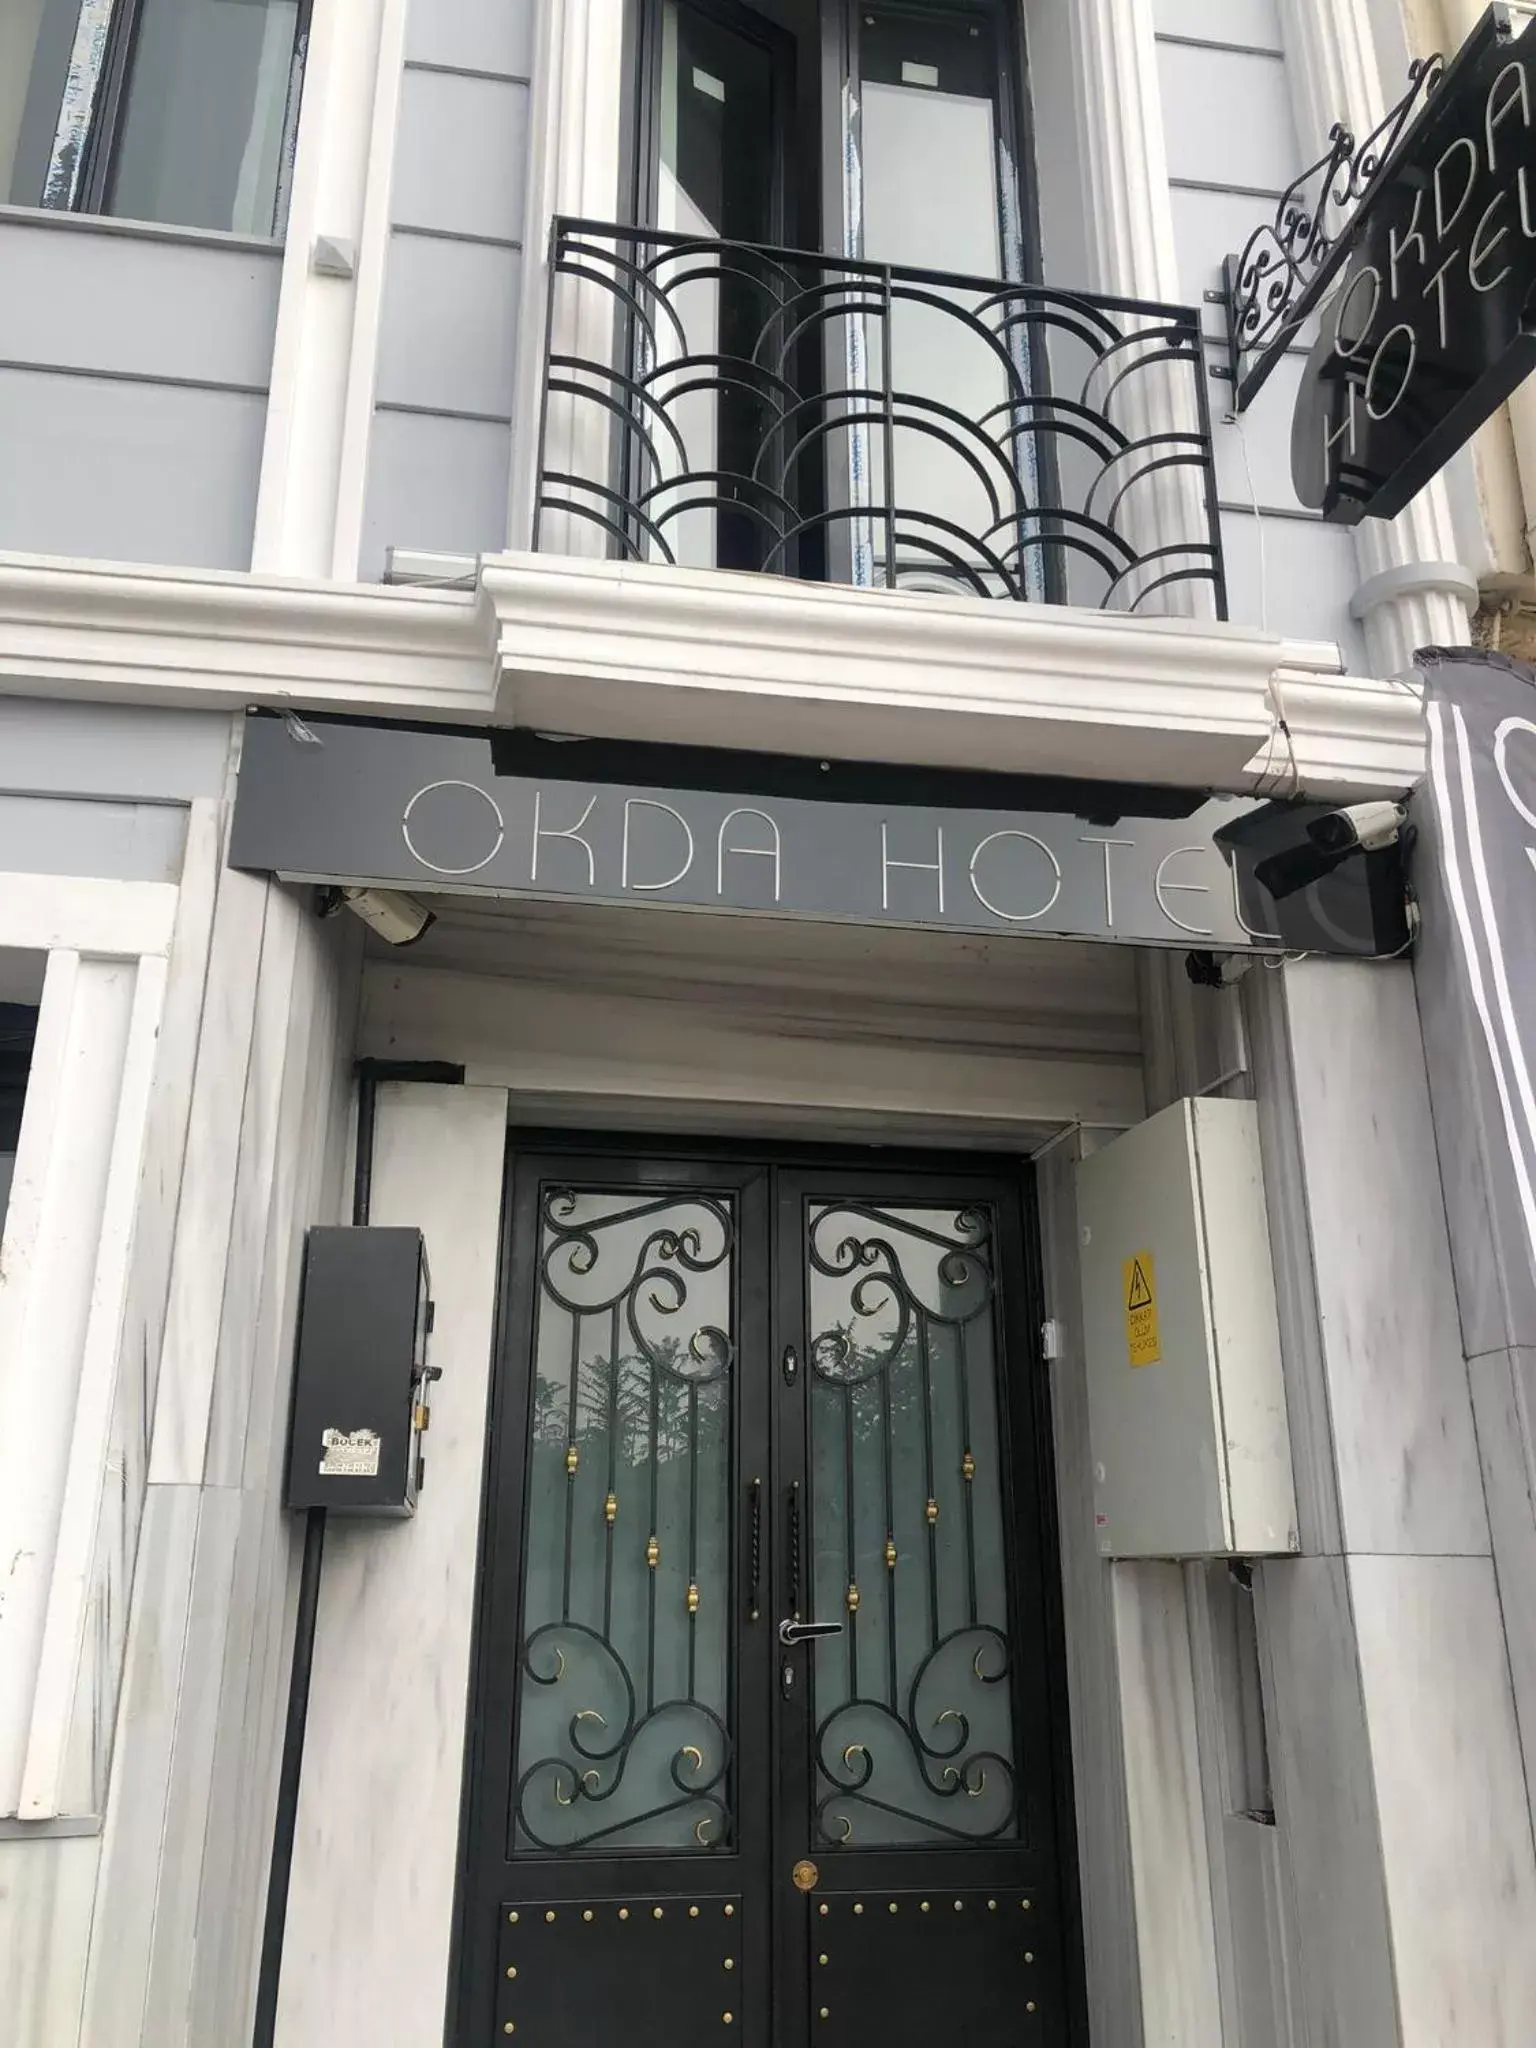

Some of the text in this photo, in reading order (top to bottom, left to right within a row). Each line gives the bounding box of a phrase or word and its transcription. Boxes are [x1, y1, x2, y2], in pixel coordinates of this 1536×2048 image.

[1322, 166, 1536, 486] HOTEL
[1334, 61, 1530, 358] OKDA
[402, 780, 1282, 940] OKDA HOTEL
